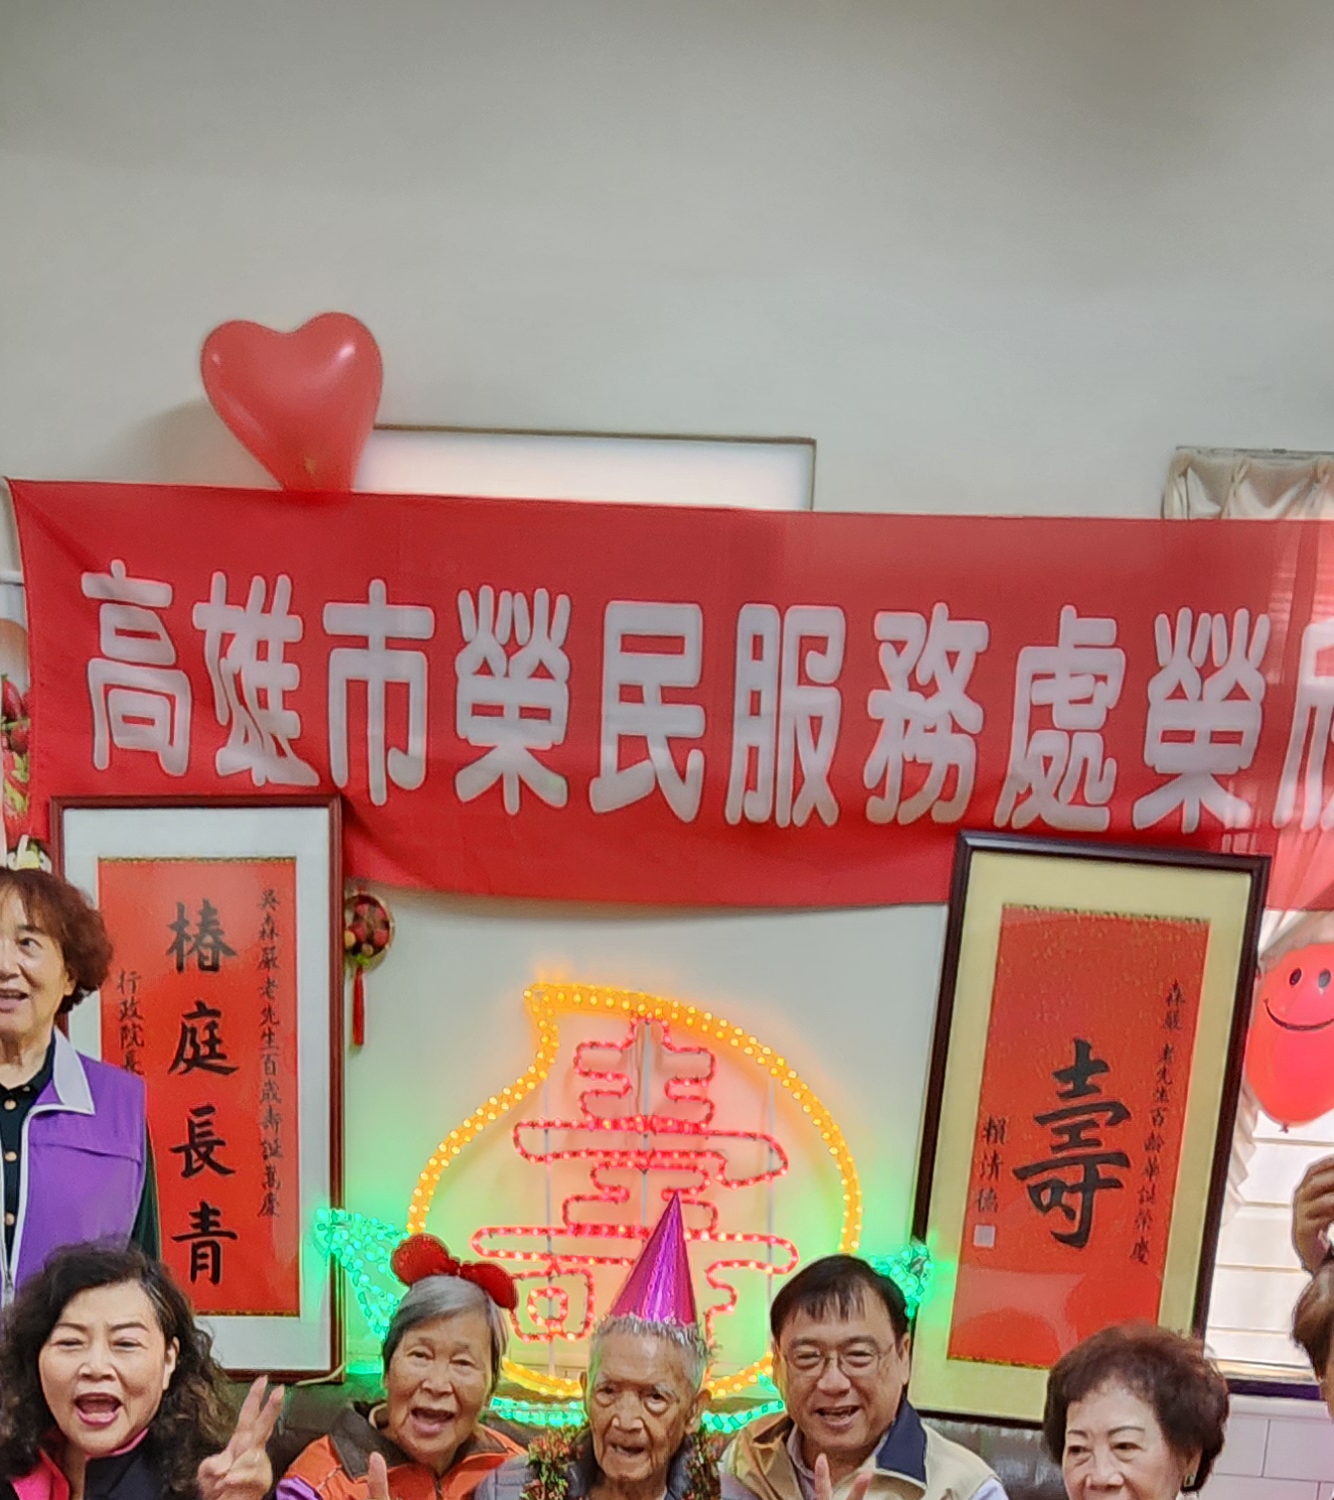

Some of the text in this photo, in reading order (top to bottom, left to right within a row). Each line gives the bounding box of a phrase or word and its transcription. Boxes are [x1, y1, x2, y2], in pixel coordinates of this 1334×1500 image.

[165, 898, 240, 1287] 椿庭長青
[1011, 1037, 1132, 1250] 壽
